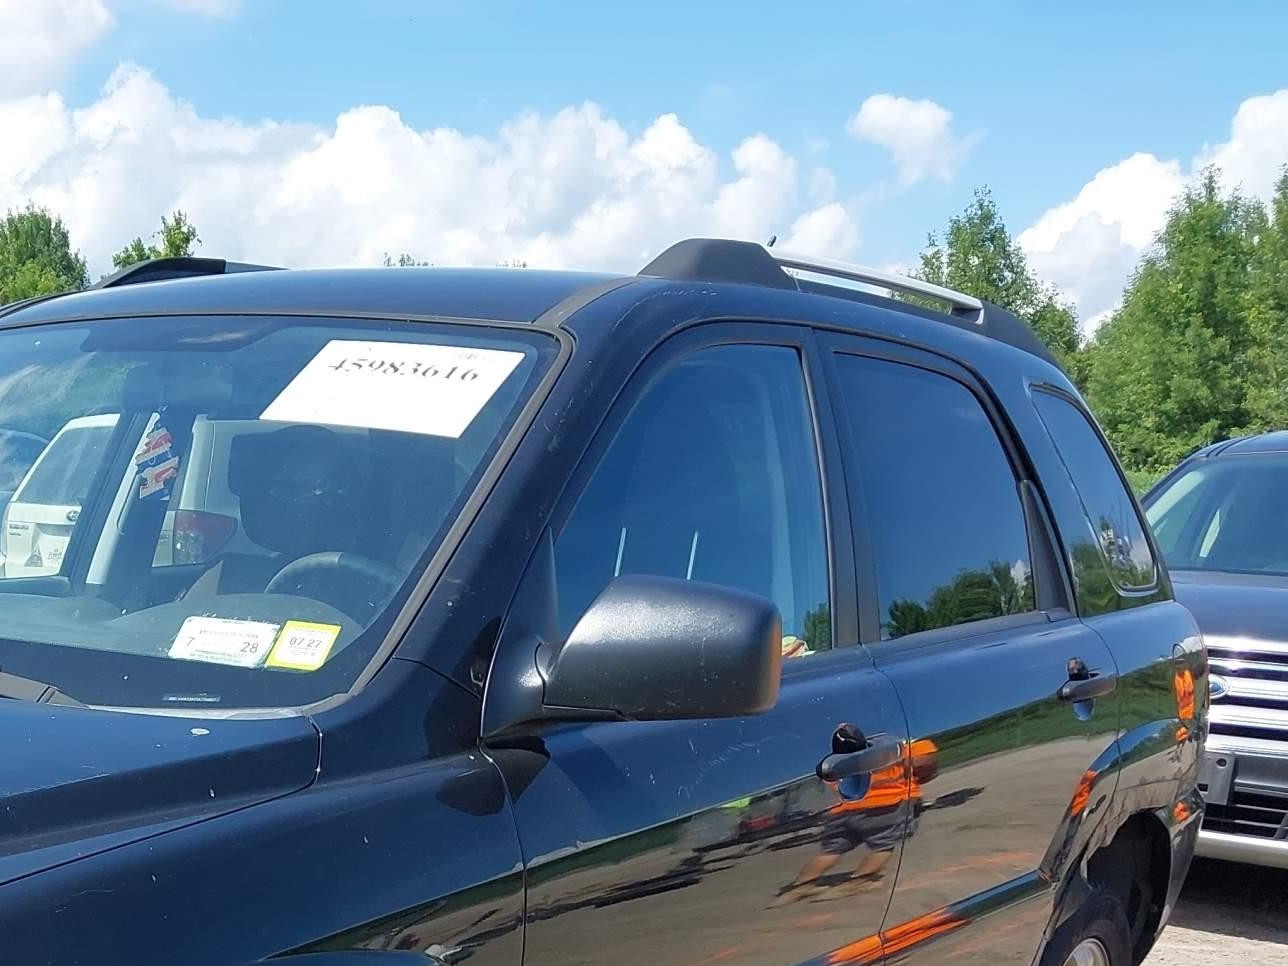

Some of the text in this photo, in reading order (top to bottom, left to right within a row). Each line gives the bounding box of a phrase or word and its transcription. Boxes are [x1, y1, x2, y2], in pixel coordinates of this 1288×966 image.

[328, 358, 479, 381] 45983616
[240, 642, 259, 654] 28
[306, 639, 323, 649] 27
